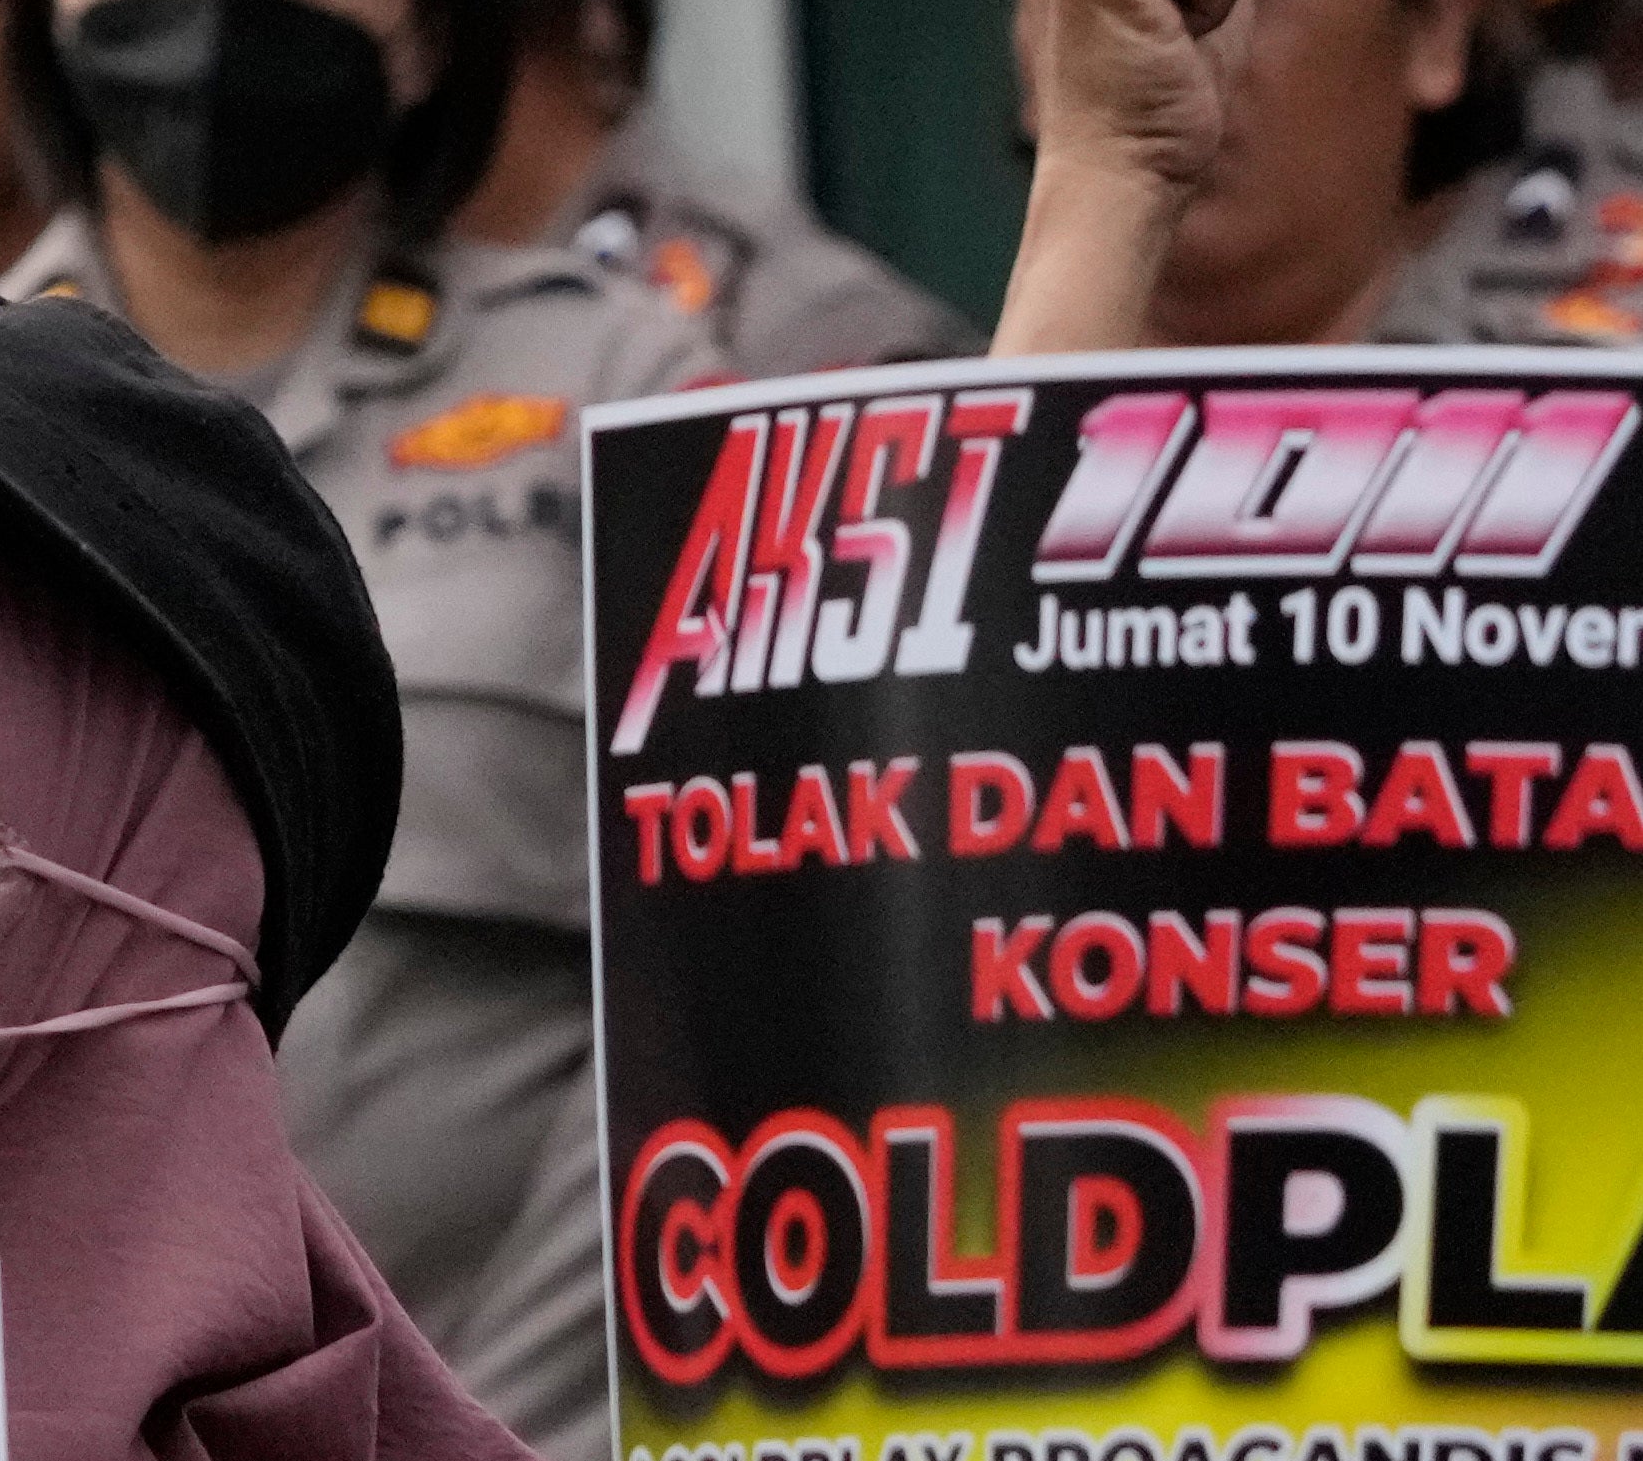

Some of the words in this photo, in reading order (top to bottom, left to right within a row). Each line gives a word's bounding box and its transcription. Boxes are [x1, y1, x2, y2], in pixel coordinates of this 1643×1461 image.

[609, 389, 1034, 755] AKSI
[1015, 596, 1256, 671] Jumat
[1280, 589, 1373, 665] 10
[624, 755, 921, 886] TOLAK
[949, 741, 1224, 857] DAN
[971, 907, 1520, 1022] KONSER
